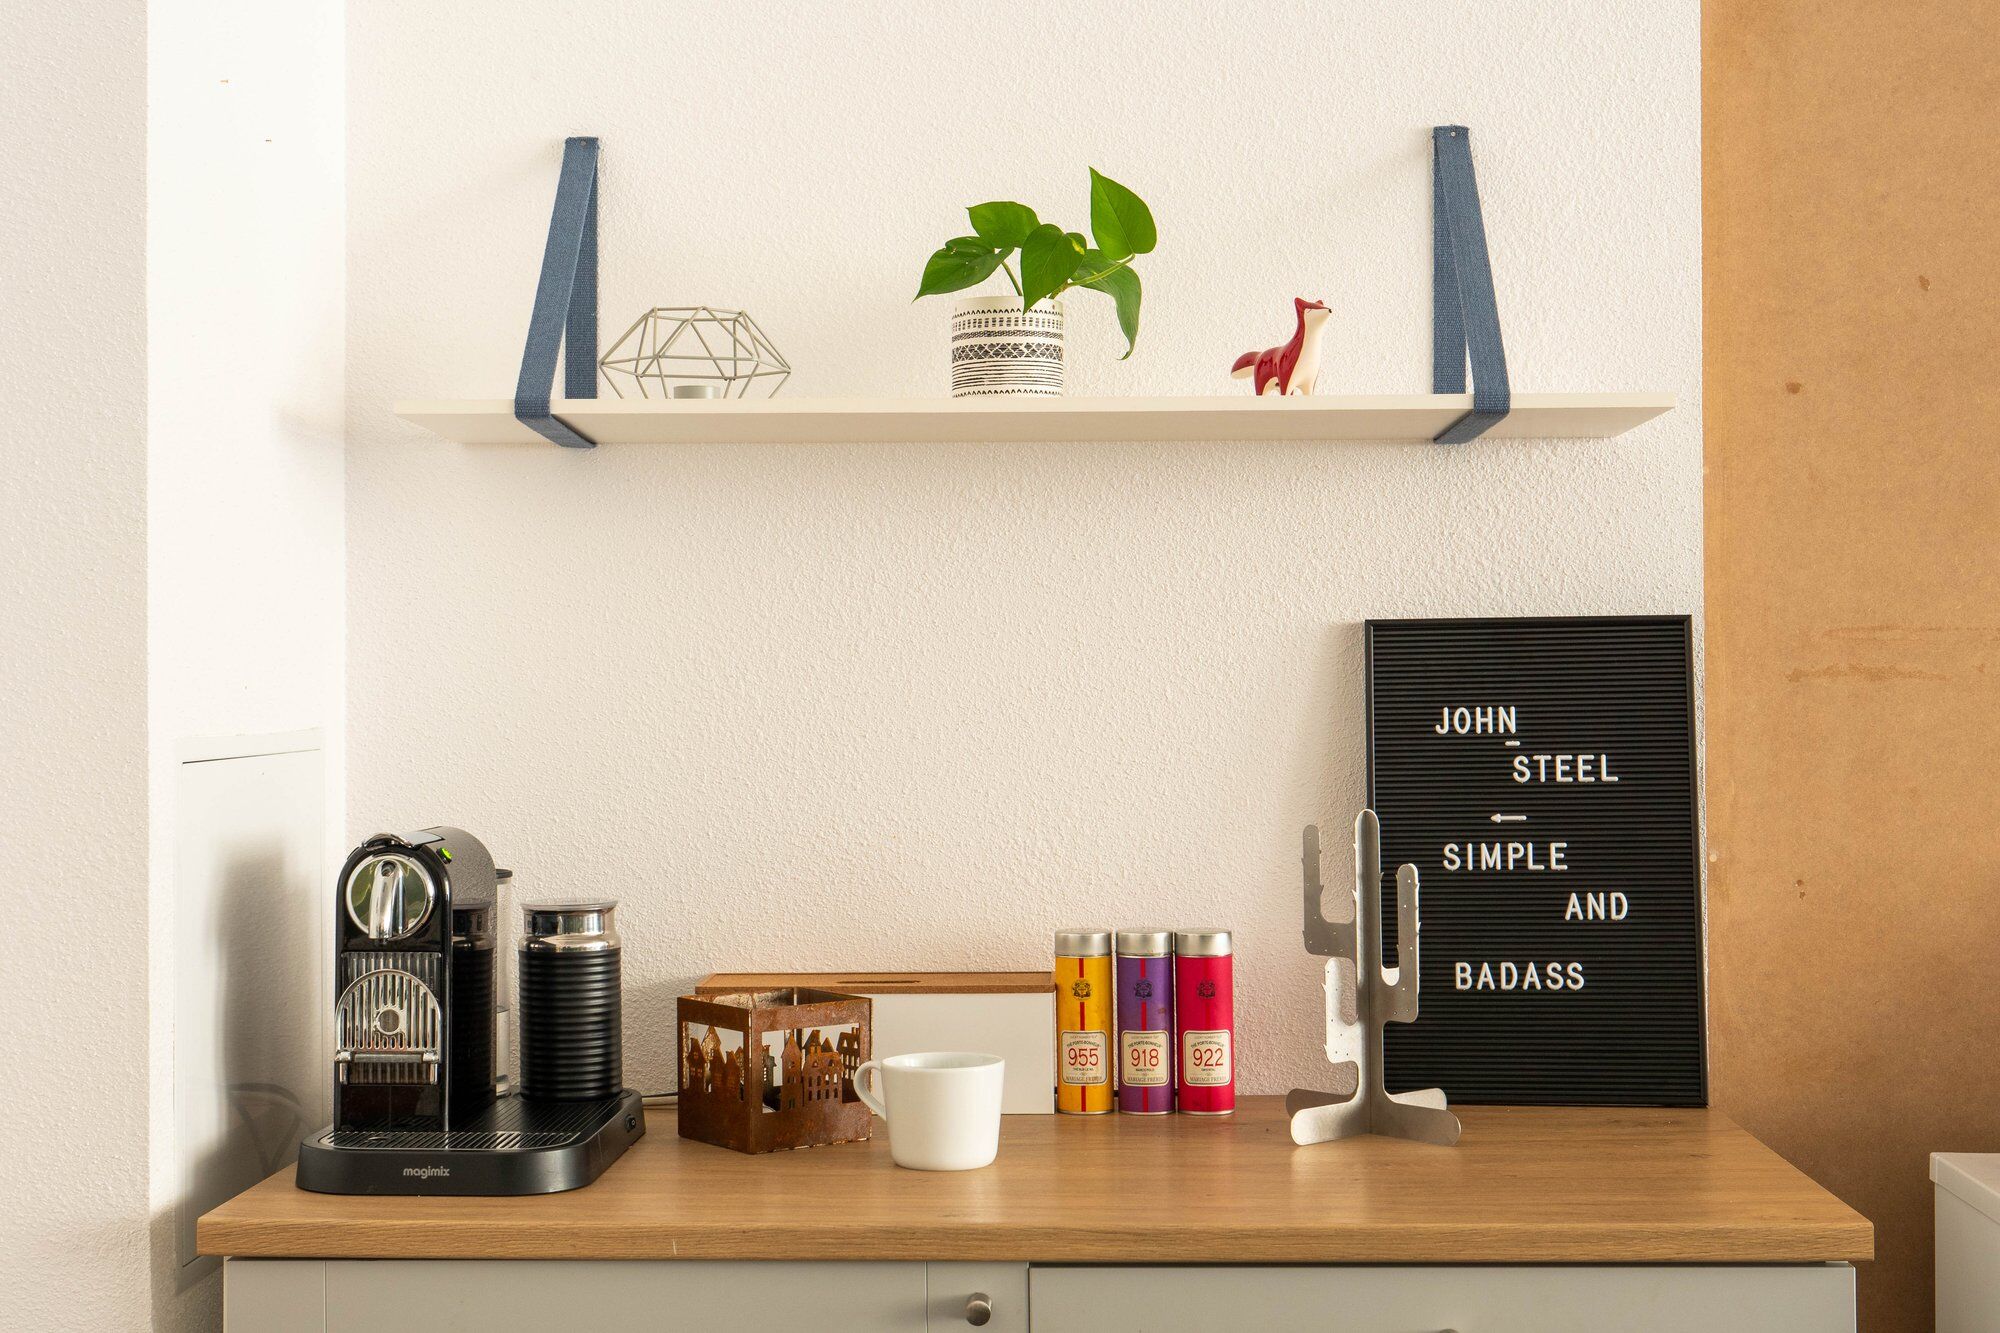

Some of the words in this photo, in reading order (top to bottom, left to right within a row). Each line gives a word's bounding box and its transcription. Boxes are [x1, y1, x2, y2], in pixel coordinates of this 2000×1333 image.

[1435, 706, 1517, 735] JOHN
[1512, 753, 1619, 783] STEEL
[1443, 842, 1568, 871] SIMPLE
[1564, 892, 1629, 921] AND
[1455, 961, 1585, 990] BADASS
[1068, 1047, 1099, 1066] 955
[1131, 1048, 1159, 1067] 918
[1193, 1048, 1223, 1067] 922
[403, 1165, 450, 1179] magimix
